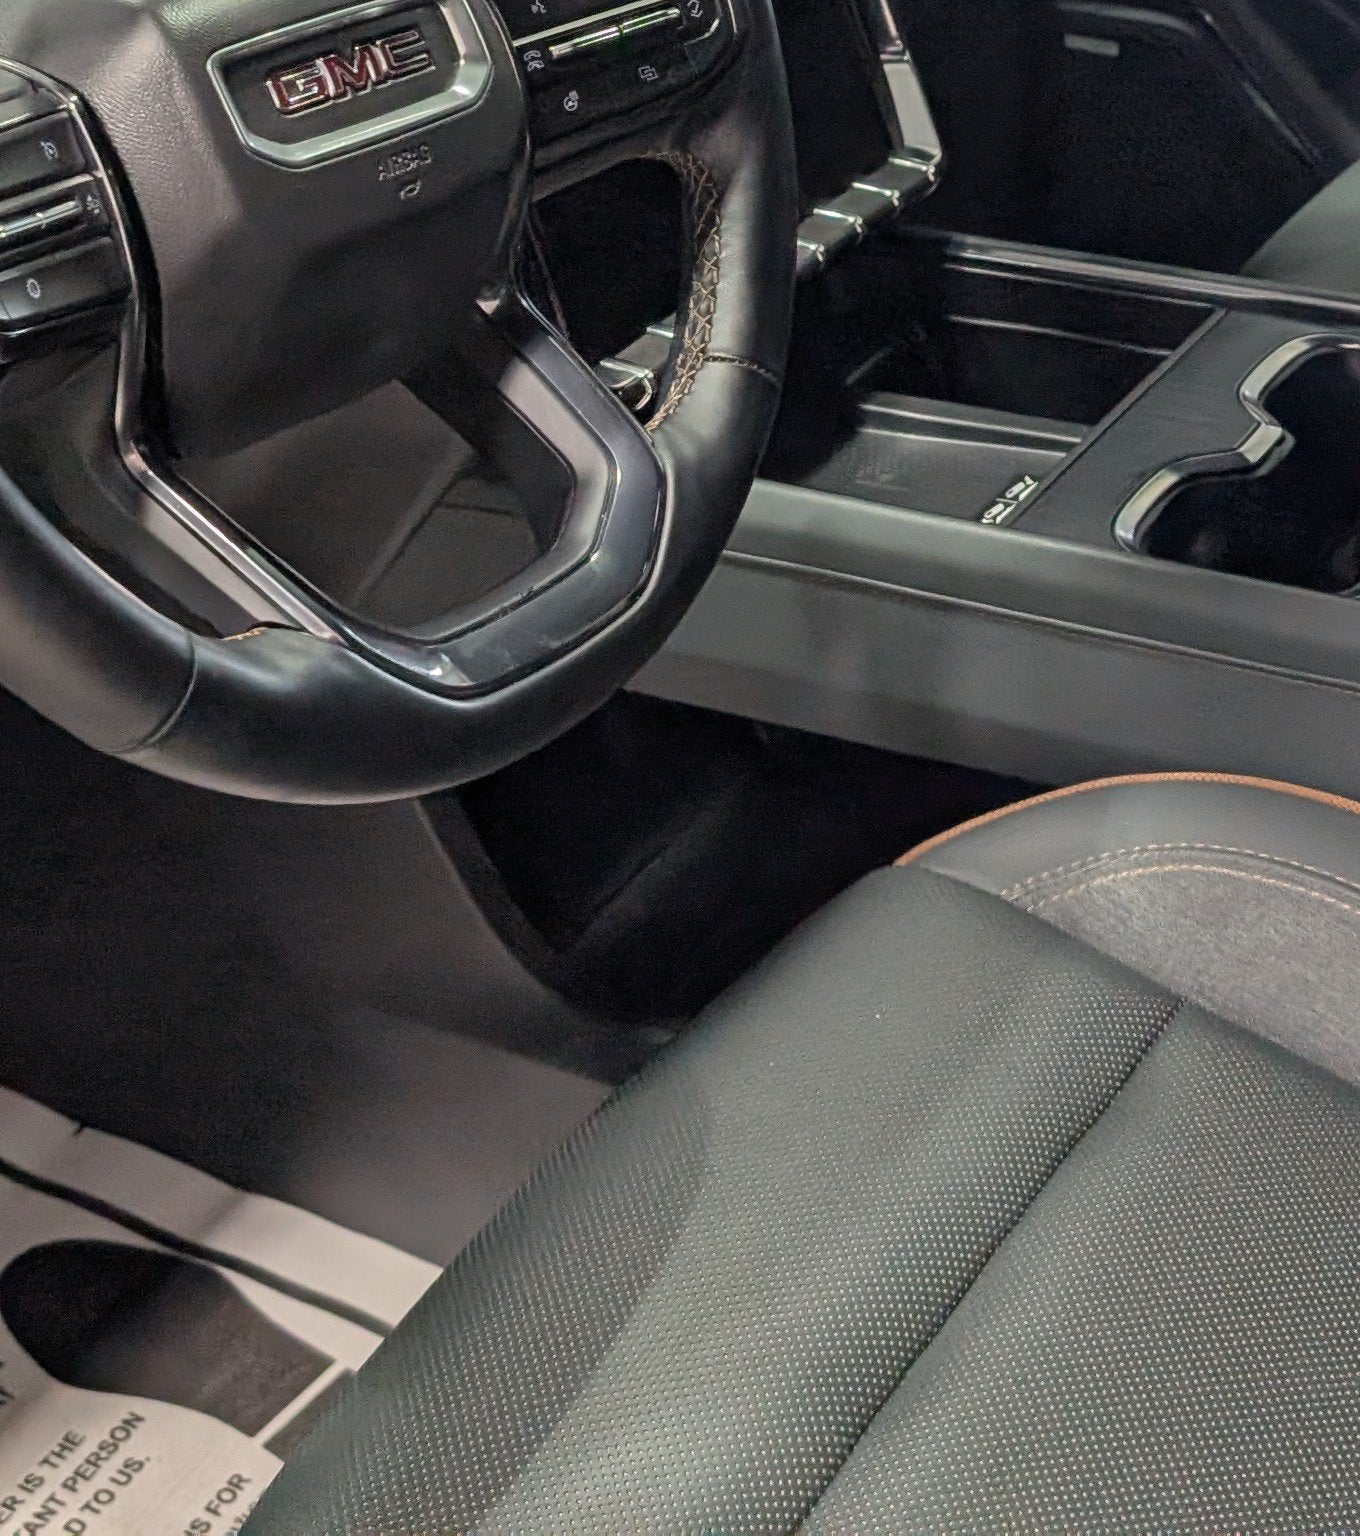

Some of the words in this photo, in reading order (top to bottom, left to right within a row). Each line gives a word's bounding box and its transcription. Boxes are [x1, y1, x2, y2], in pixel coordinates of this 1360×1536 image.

[264, 28, 436, 118] GMC
[14, 1491, 67, 1536] ANT
[61, 1410, 147, 1493] PERSON
[17, 1472, 45, 1494] IS
[38, 1429, 87, 1469] THE
[78, 1488, 116, 1514] TO
[204, 1472, 253, 1517] FOR
